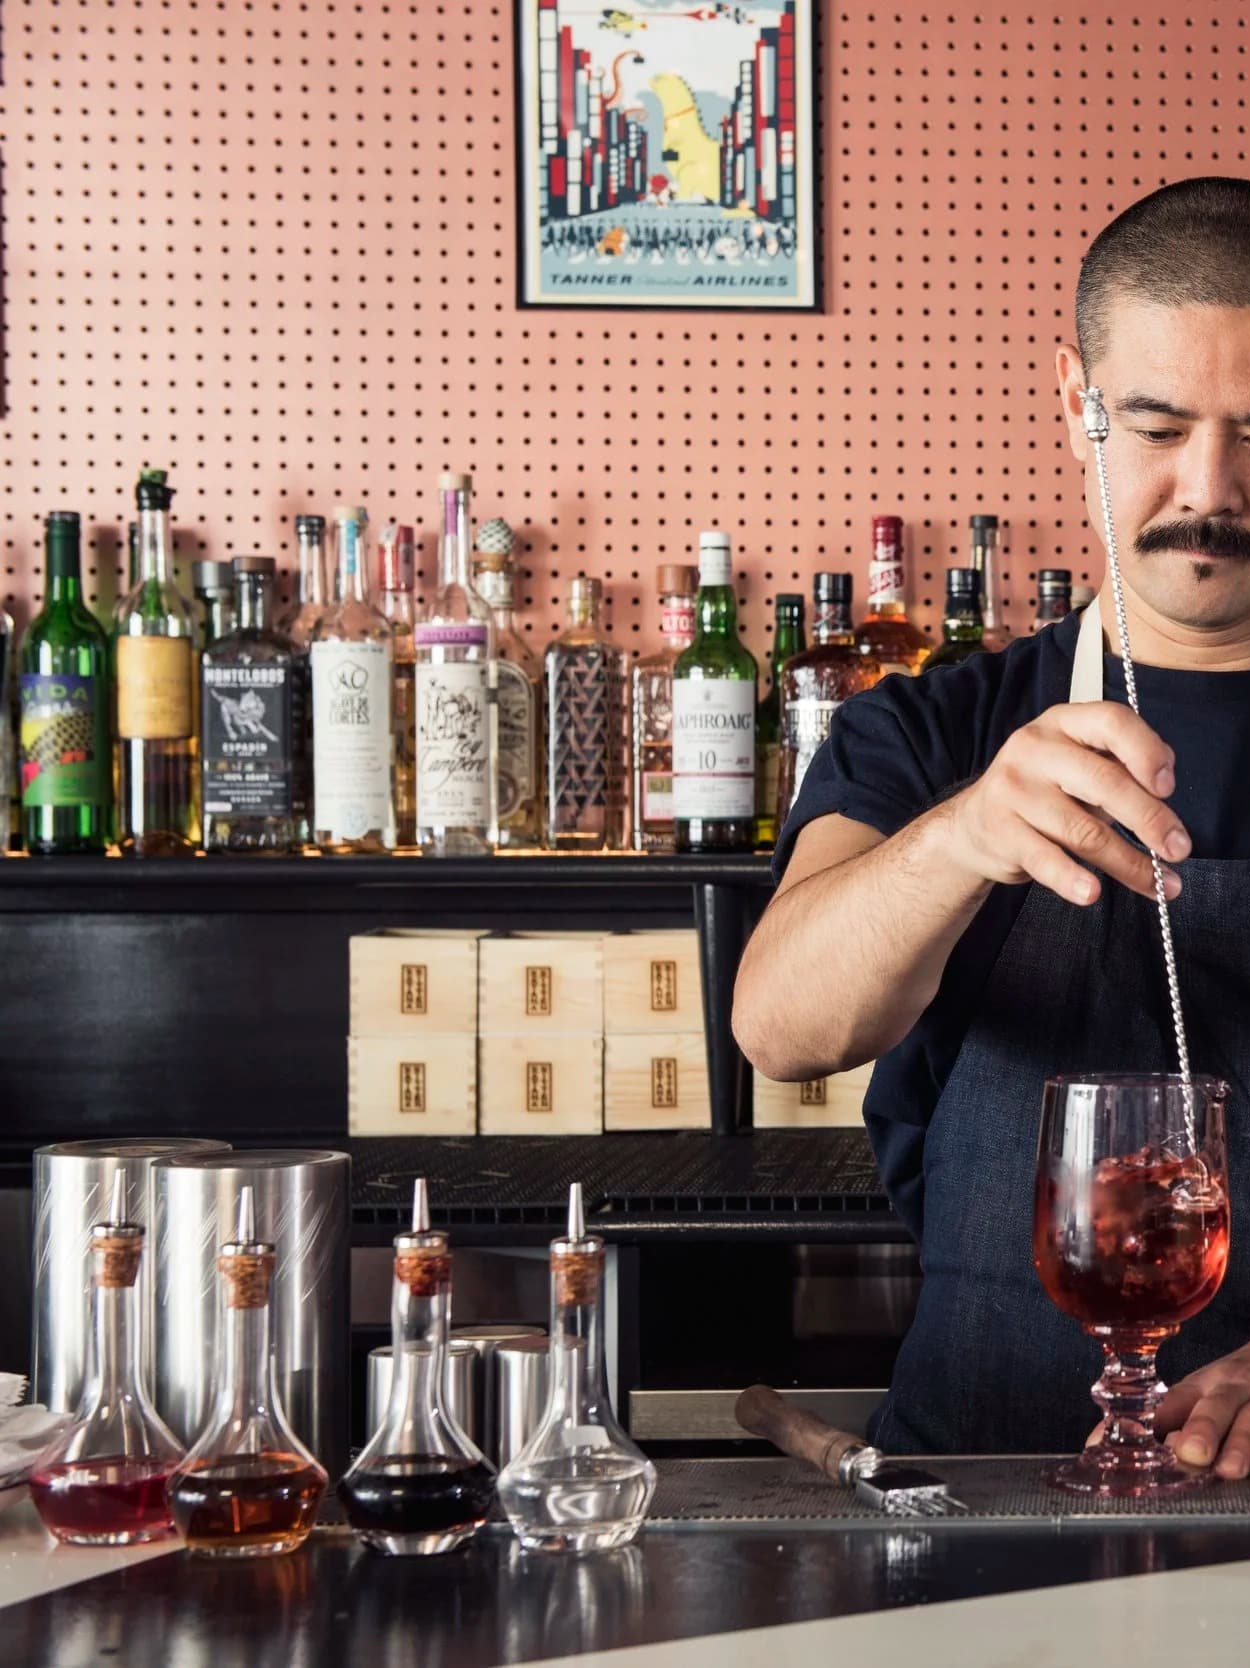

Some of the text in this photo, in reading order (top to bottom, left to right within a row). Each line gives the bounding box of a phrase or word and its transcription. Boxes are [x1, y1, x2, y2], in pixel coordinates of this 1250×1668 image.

[550, 273, 633, 285] TANNER
[693, 274, 789, 286] AIRLINES
[22, 684, 89, 702] VIDA
[676, 712, 752, 730] APHROAIG
[698, 750, 717, 770] 10
